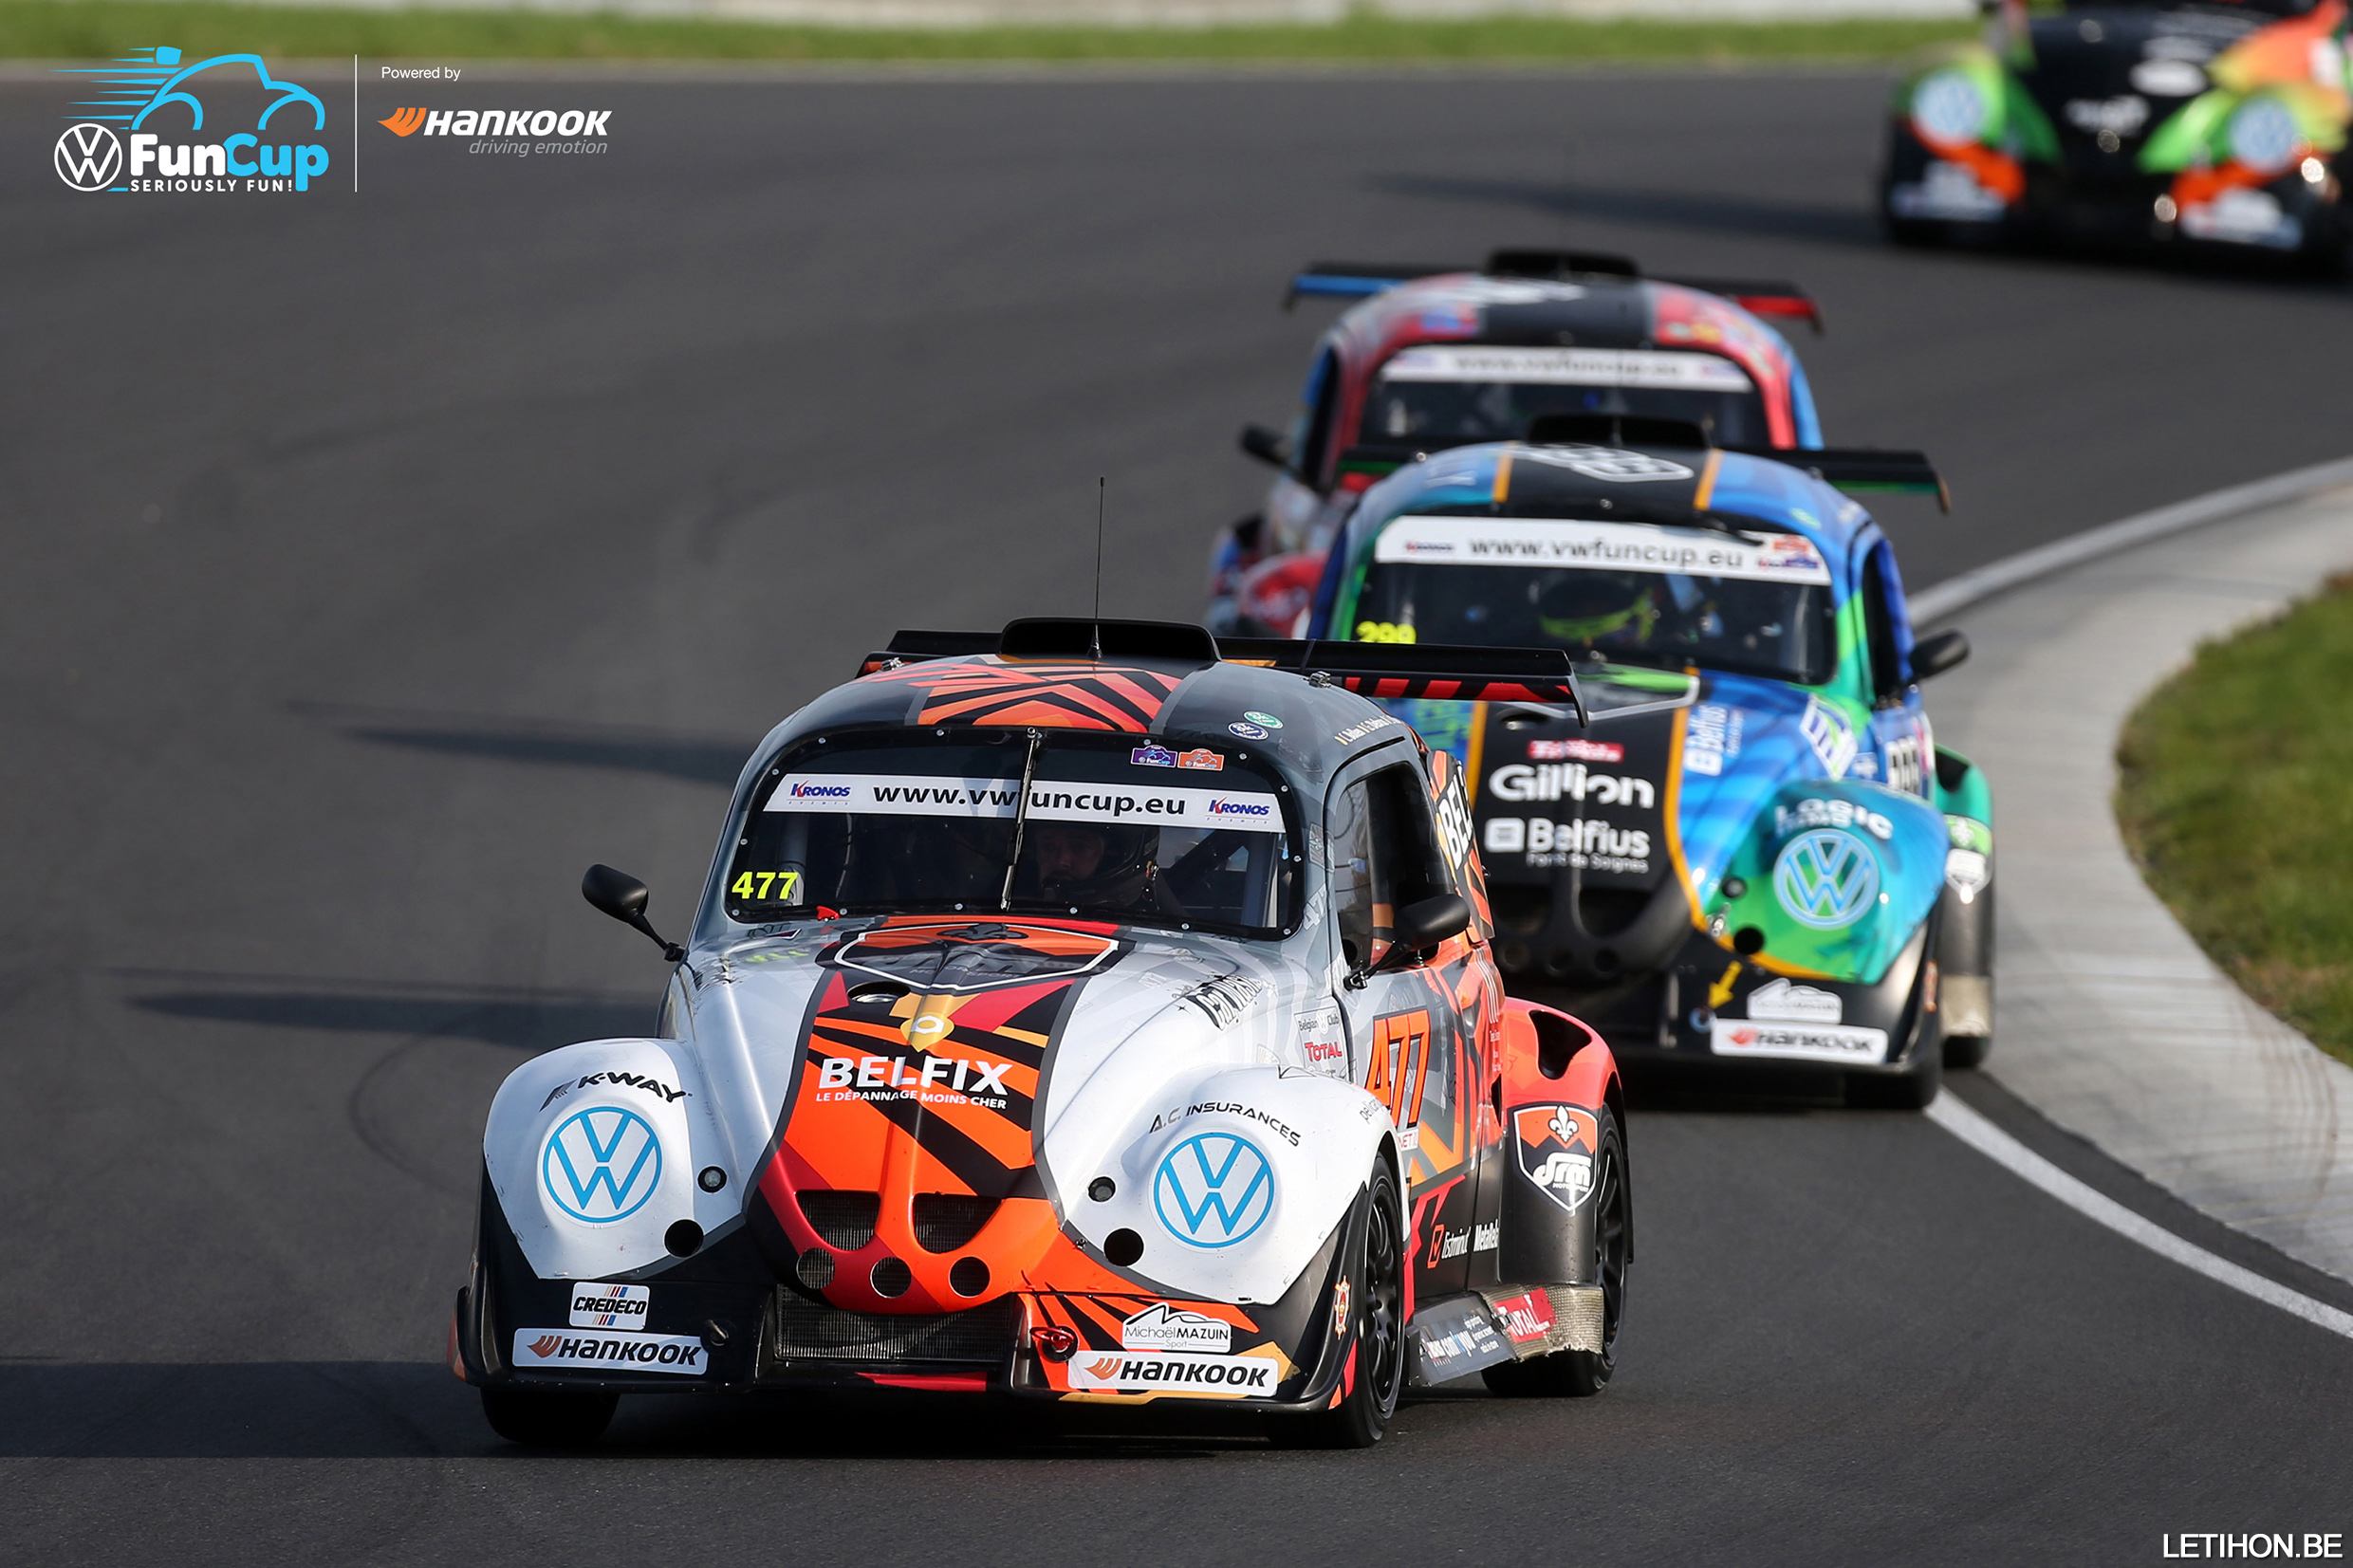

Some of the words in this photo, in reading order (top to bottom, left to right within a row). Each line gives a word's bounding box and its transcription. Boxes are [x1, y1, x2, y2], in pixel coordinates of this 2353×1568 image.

[790, 779, 851, 798] KRONOS
[1489, 763, 1656, 809] Gillion
[873, 785, 1186, 817] www.vwuncup.eu
[1208, 796, 1270, 816] KRONOS
[1528, 818, 1651, 859] Belfius
[732, 871, 799, 899] 477
[1298, 1020, 1318, 1033] Belgian
[819, 1055, 1013, 1096] BELFIX
[1364, 1009, 1431, 1129] 477
[816, 1092, 831, 1102] LE
[834, 1089, 917, 1102] DÉPANNAGE
[920, 1092, 967, 1105] MOINS
[970, 1096, 1008, 1110] CHER
[1149, 1107, 1182, 1134] A.C.
[1185, 1101, 1302, 1147] INSURANCES
[573, 1296, 647, 1315] CREDECO
[1165, 1340, 1188, 1349] Sport
